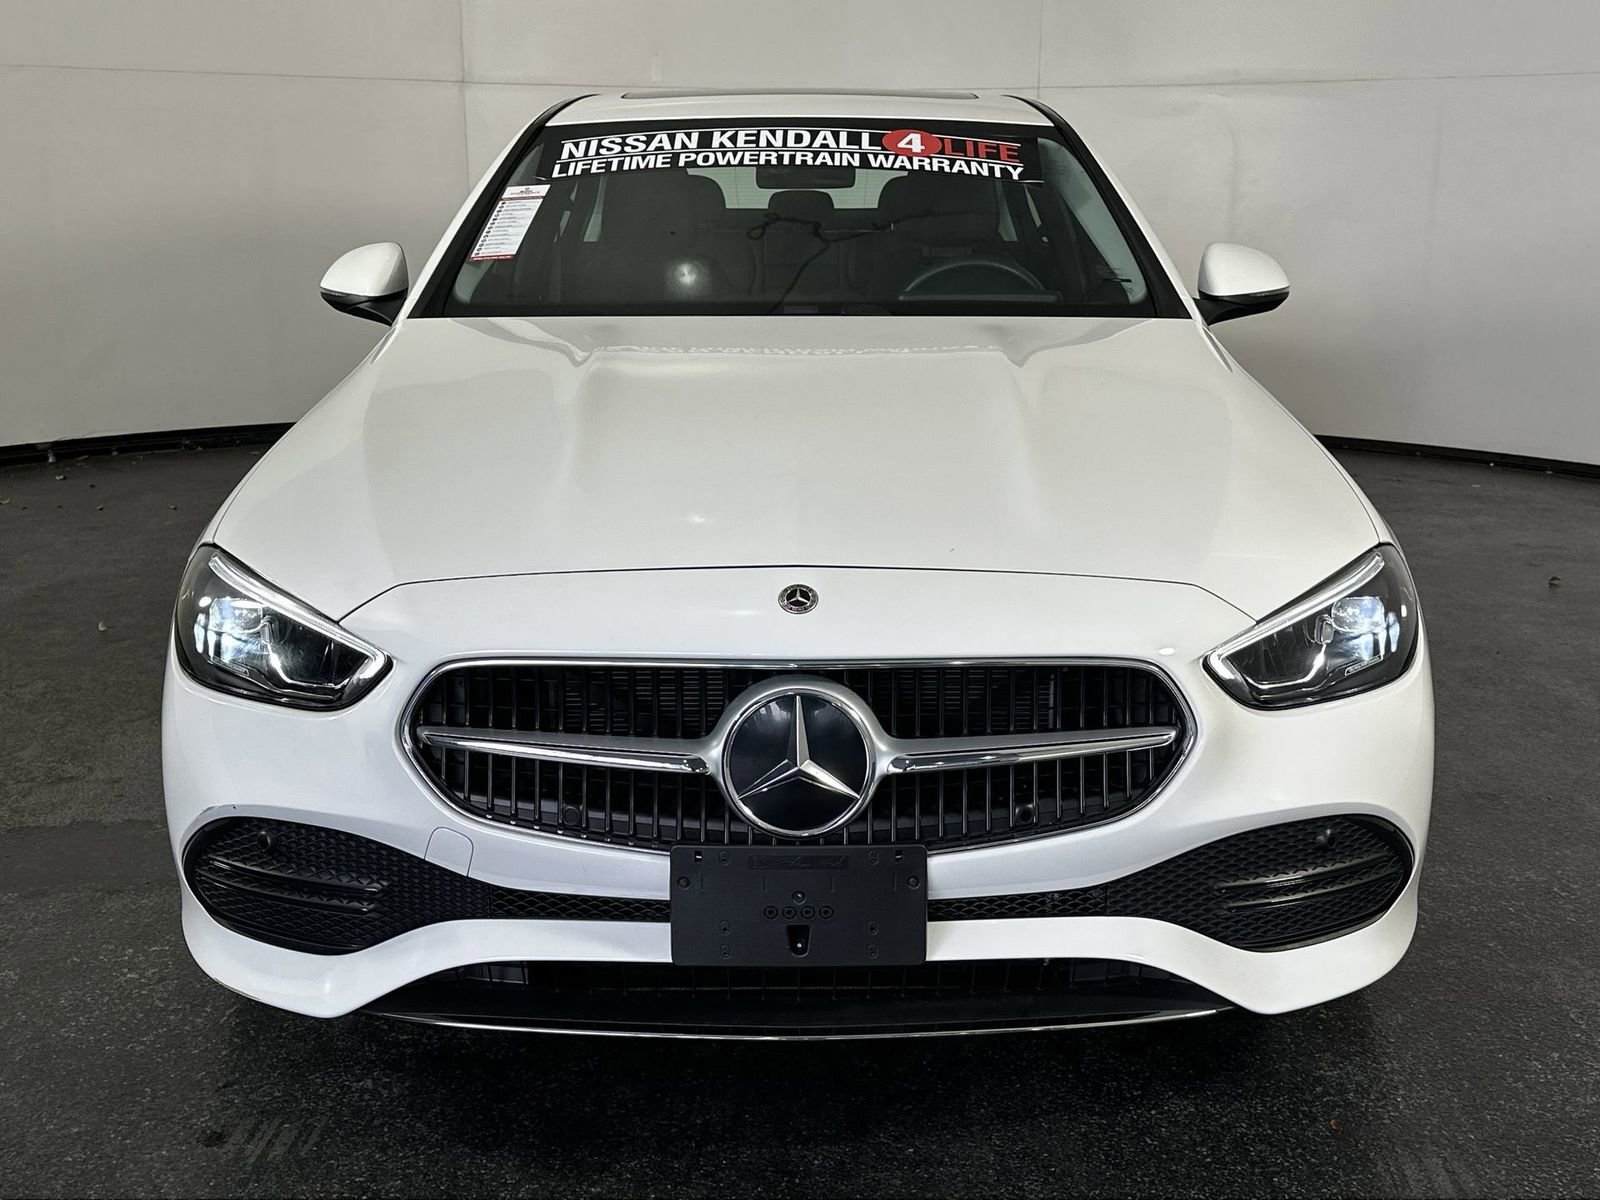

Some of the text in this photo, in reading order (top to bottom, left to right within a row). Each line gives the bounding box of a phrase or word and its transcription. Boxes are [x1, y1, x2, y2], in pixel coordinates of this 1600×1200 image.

[561, 129, 1022, 163] NISSAN KENDALL 4 LIFE
[552, 151, 1024, 181] LIFETIME POWERTRAIN WARRANTY
